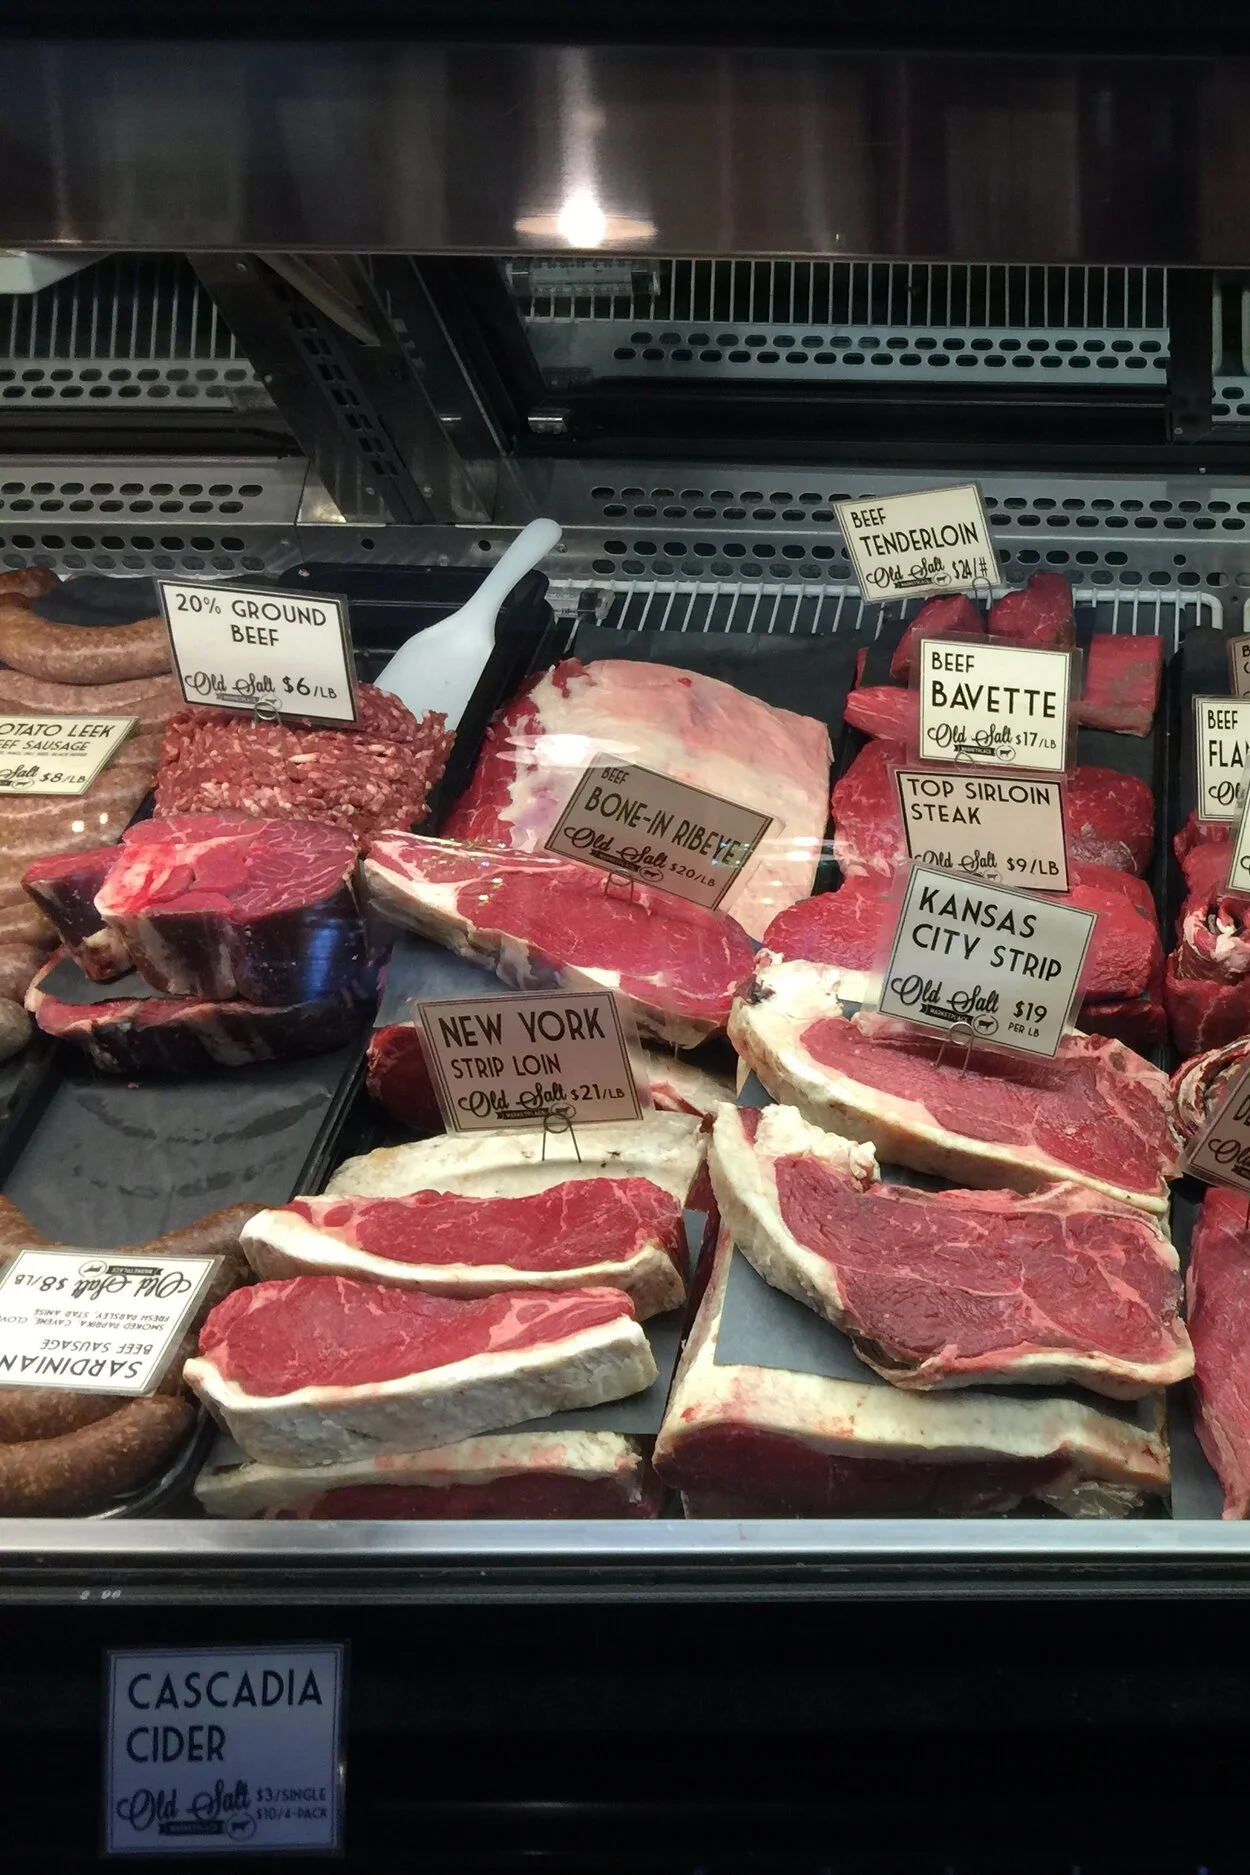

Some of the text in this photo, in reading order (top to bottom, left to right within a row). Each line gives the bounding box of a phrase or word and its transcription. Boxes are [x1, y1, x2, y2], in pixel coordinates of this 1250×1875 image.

[850, 508, 886, 528] BEEF
[859, 522, 979, 558] TENDERLOIN
[866, 565, 903, 588] Old
[908, 556, 945, 580] Salt
[176, 593, 326, 626] 20% GROUND
[230, 624, 279, 647] BEEF
[932, 652, 974, 673] BEEF
[185, 671, 226, 696] Old
[232, 672, 276, 695] Salt
[931, 680, 1057, 718] BAVETTE
[0, 723, 115, 738] OTATO LEEK
[1208, 710, 1239, 730] BEEF
[22, 740, 91, 751] SAUSAGE
[927, 723, 966, 748] Old
[972, 723, 1013, 747] Salt
[600, 767, 629, 785] BEEF
[907, 779, 1051, 805] TOP SIRLOIN
[584, 786, 742, 865] BONE-IN RIBEYE
[911, 803, 981, 825] STEAK
[563, 827, 614, 848] Old
[616, 846, 669, 868] Salt
[958, 850, 998, 872] Salt
[919, 887, 1037, 938] KANSAS
[912, 923, 1062, 981] CITY STRIP
[891, 975, 1048, 1023] Old Salt $19
[438, 1007, 606, 1048] NEW YORK
[1008, 1022, 1040, 1038] PER LB
[450, 1053, 562, 1079] STRIP LOIN
[458, 1090, 510, 1117] Old
[516, 1082, 568, 1110] Salt
[71, 1274, 132, 1301] Salt
[134, 1271, 192, 1299] Old
[33, 1308, 62, 1317] ANISE
[64, 1310, 90, 1319] STAR
[140, 1314, 170, 1323] FRESH
[123, 1322, 165, 1331] SMOKED
[39, 1338, 153, 1355] BEEF SAUSAGE
[0, 1354, 143, 1378] SARDINIAN
[128, 1668, 323, 1710] CASCADIA
[127, 1724, 226, 1763] CIDER
[116, 1779, 251, 1832] Old Salt
